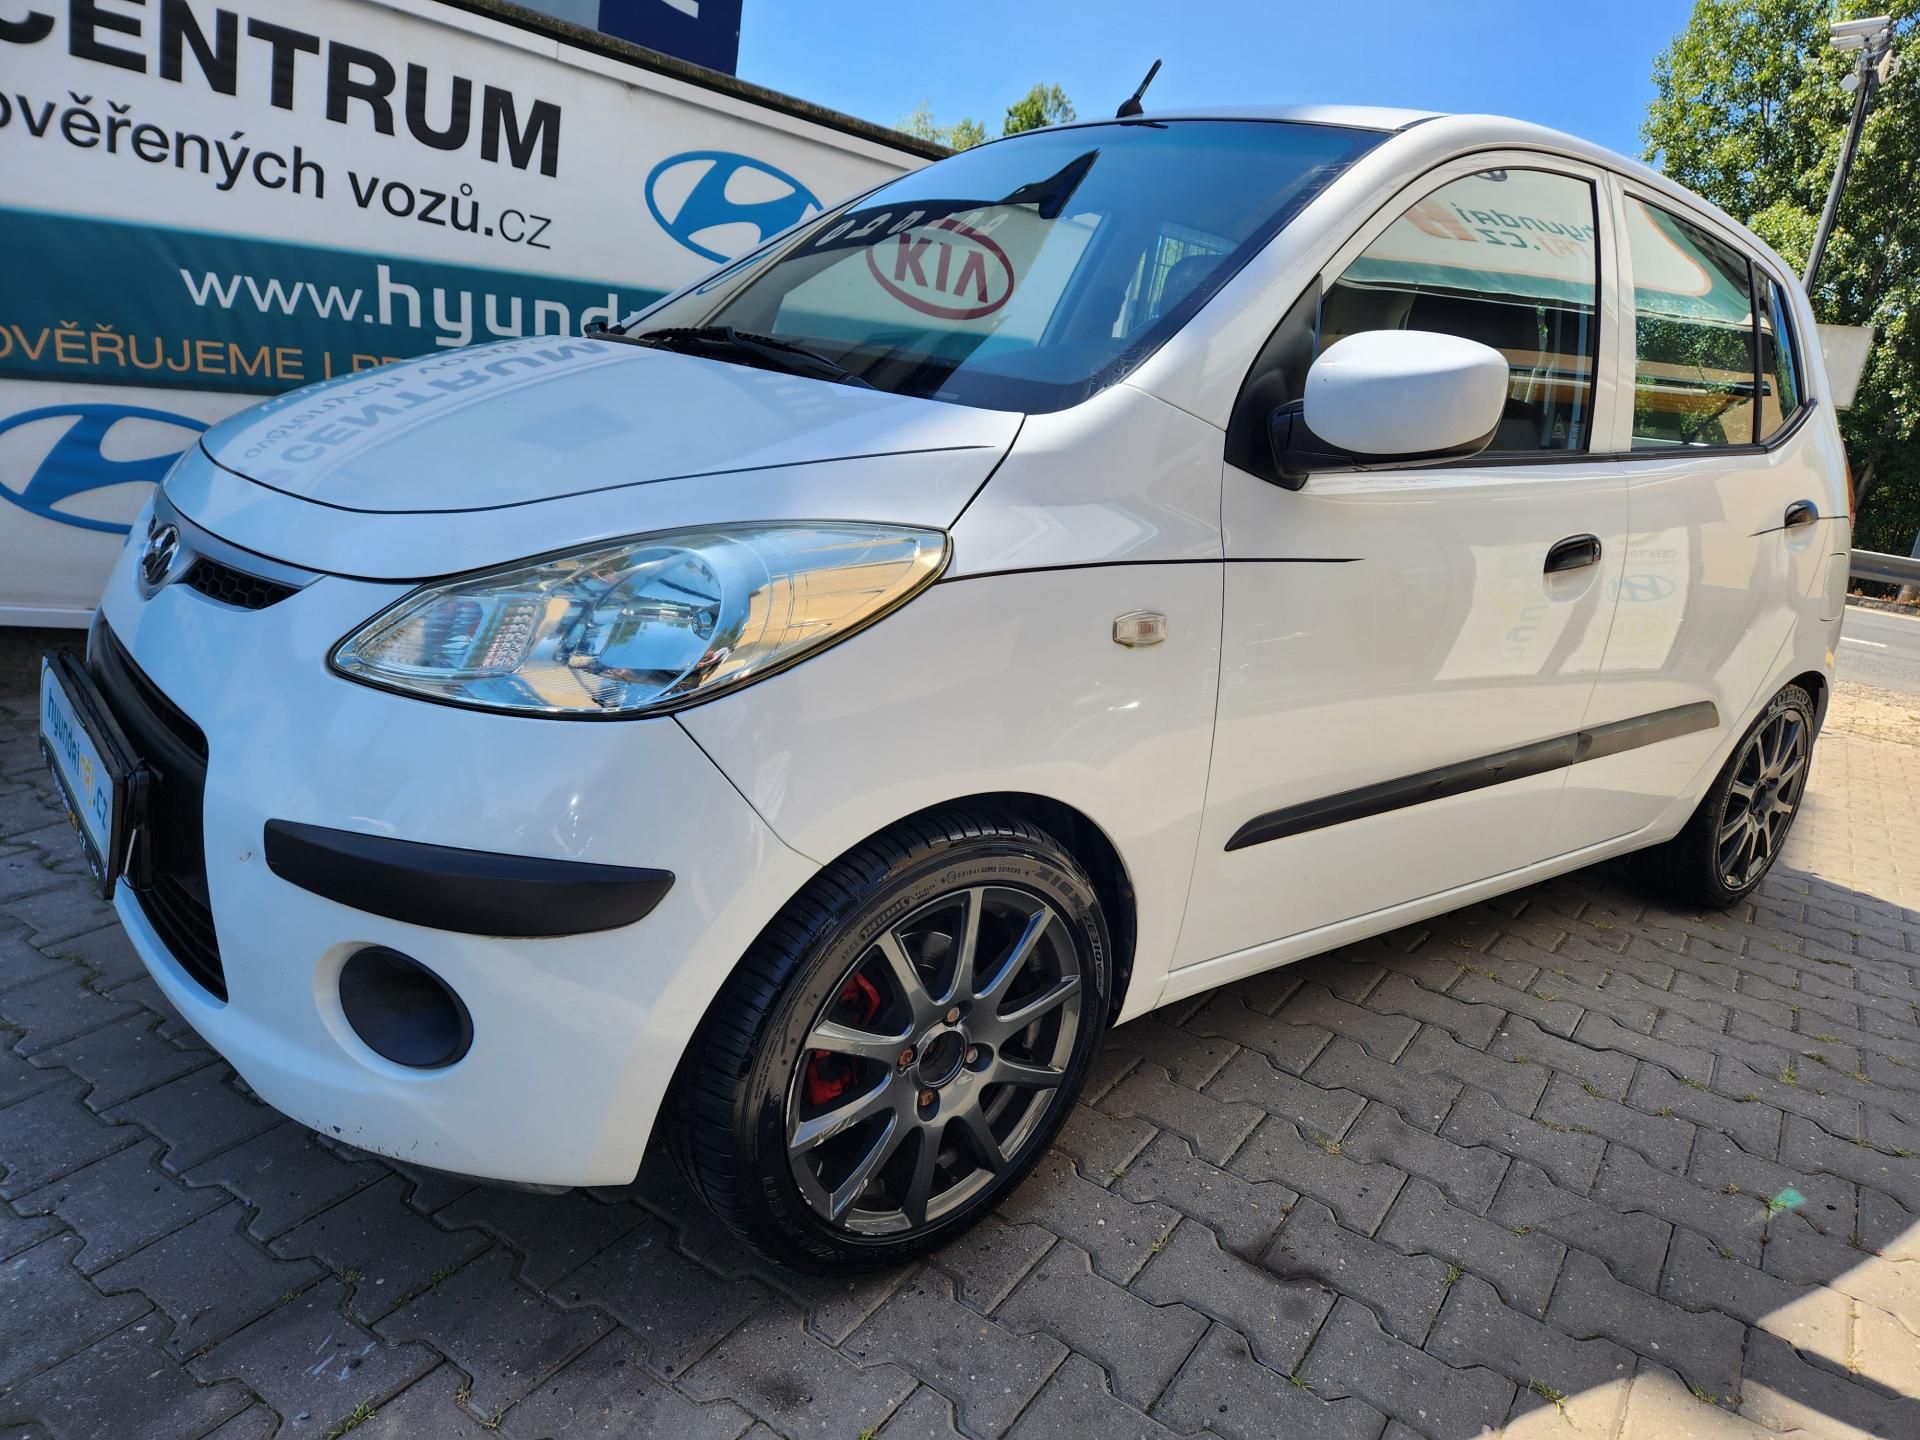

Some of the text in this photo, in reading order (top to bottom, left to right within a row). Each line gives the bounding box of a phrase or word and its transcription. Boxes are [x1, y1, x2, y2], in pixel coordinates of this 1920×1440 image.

[347, 171, 552, 250] vozů.cz
[181, 263, 641, 347] www.hyund
[894, 231, 988, 304] KIA
